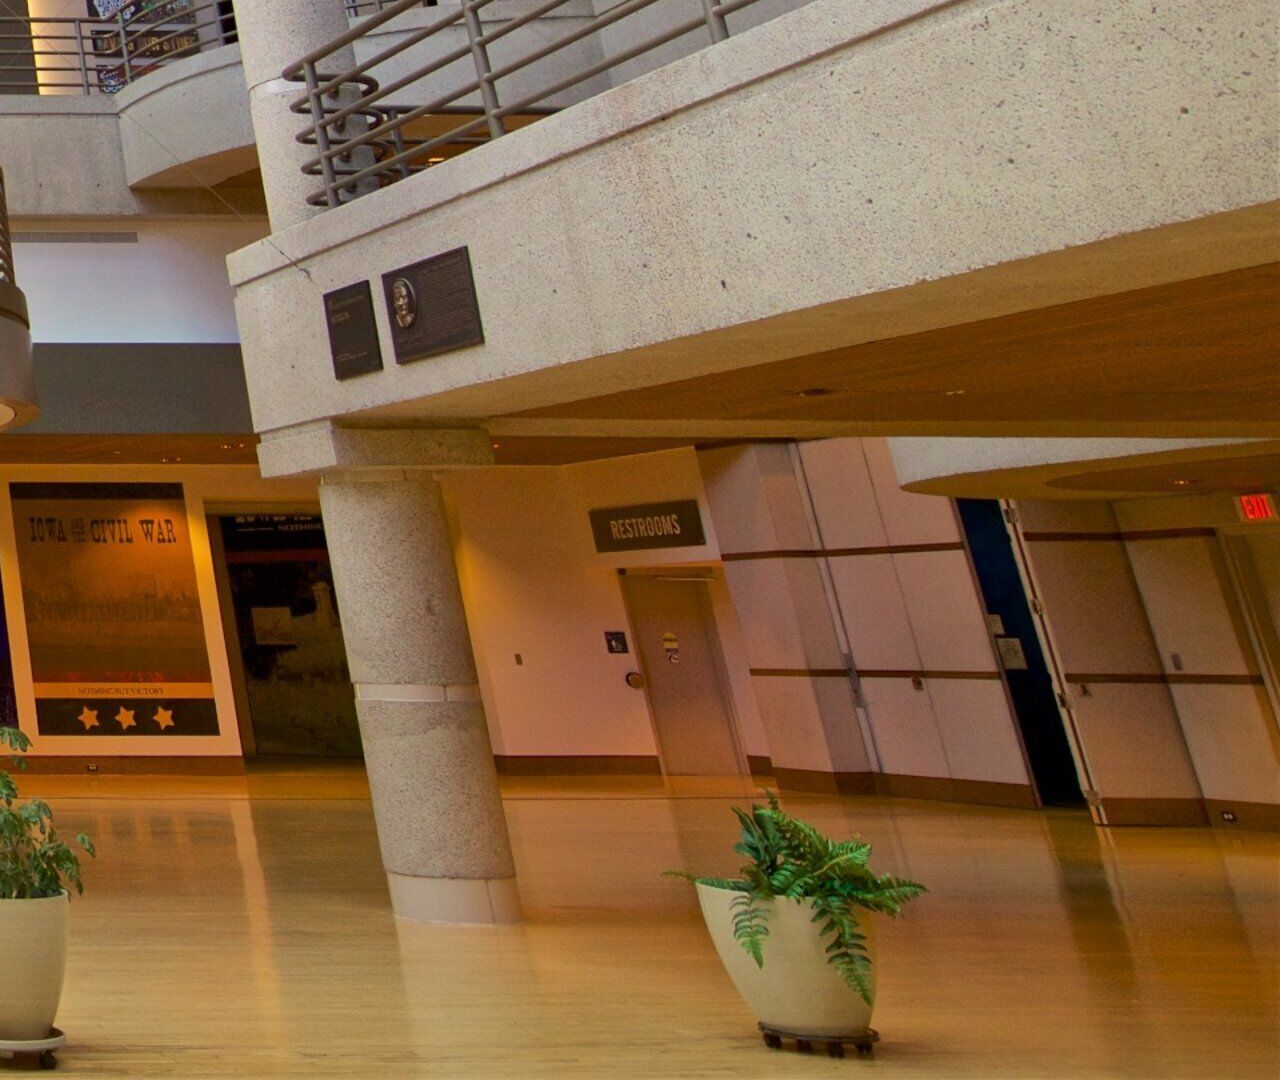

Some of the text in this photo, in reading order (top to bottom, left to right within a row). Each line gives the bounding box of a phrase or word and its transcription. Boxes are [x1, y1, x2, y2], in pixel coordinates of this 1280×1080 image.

[1241, 494, 1273, 519] EXIT
[28, 517, 67, 542] IOWA
[90, 519, 133, 544] CIVIL
[139, 519, 177, 544] WAR
[610, 514, 681, 539] RESTROOMS
